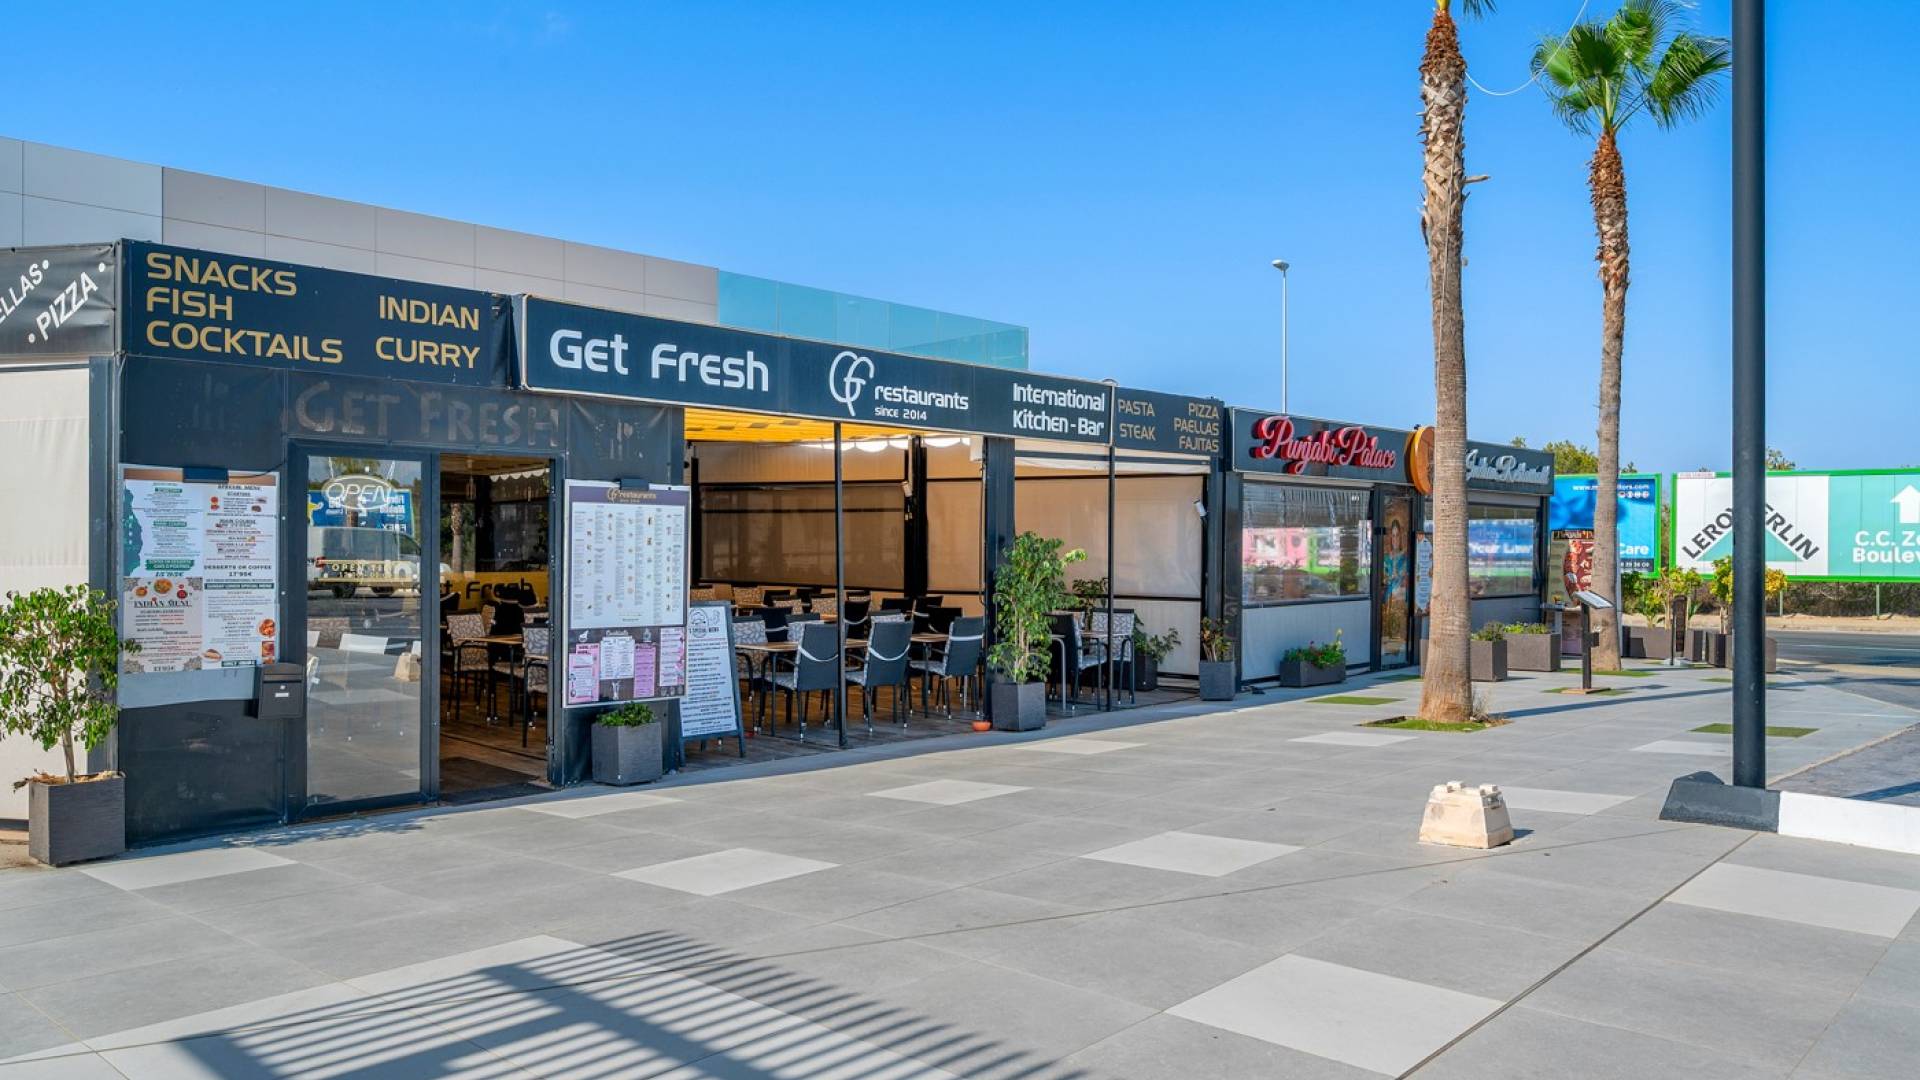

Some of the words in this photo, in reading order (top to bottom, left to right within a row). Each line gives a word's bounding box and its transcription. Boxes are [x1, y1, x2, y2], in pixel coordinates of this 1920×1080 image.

[147, 252, 297, 296] SNACKS
[36, 271, 98, 341] PIZZA
[147, 287, 233, 320] FISH
[379, 295, 480, 331] INDIAN
[147, 320, 344, 364] COCKTAILS
[375, 336, 480, 369] CURRY
[550, 329, 629, 376] Get
[651, 343, 769, 392] Fresh
[874, 385, 969, 410] restaurants
[1013, 382, 1105, 412] International
[1118, 399, 1155, 417] PASTA
[1188, 402, 1220, 420] PIZZA
[295, 380, 400, 436] GET
[420, 391, 560, 447] FRESH
[874, 405, 899, 418] since
[903, 408, 928, 421] 2014
[1173, 417, 1220, 436] PAELLAS
[1119, 424, 1156, 441] STEAK
[1178, 435, 1220, 453] FAJITAS
[1256, 416, 1335, 474] Punjabi
[1339, 426, 1396, 469] Palace
[326, 482, 392, 503] OPEN
[1855, 530, 1896, 547] C.C.
